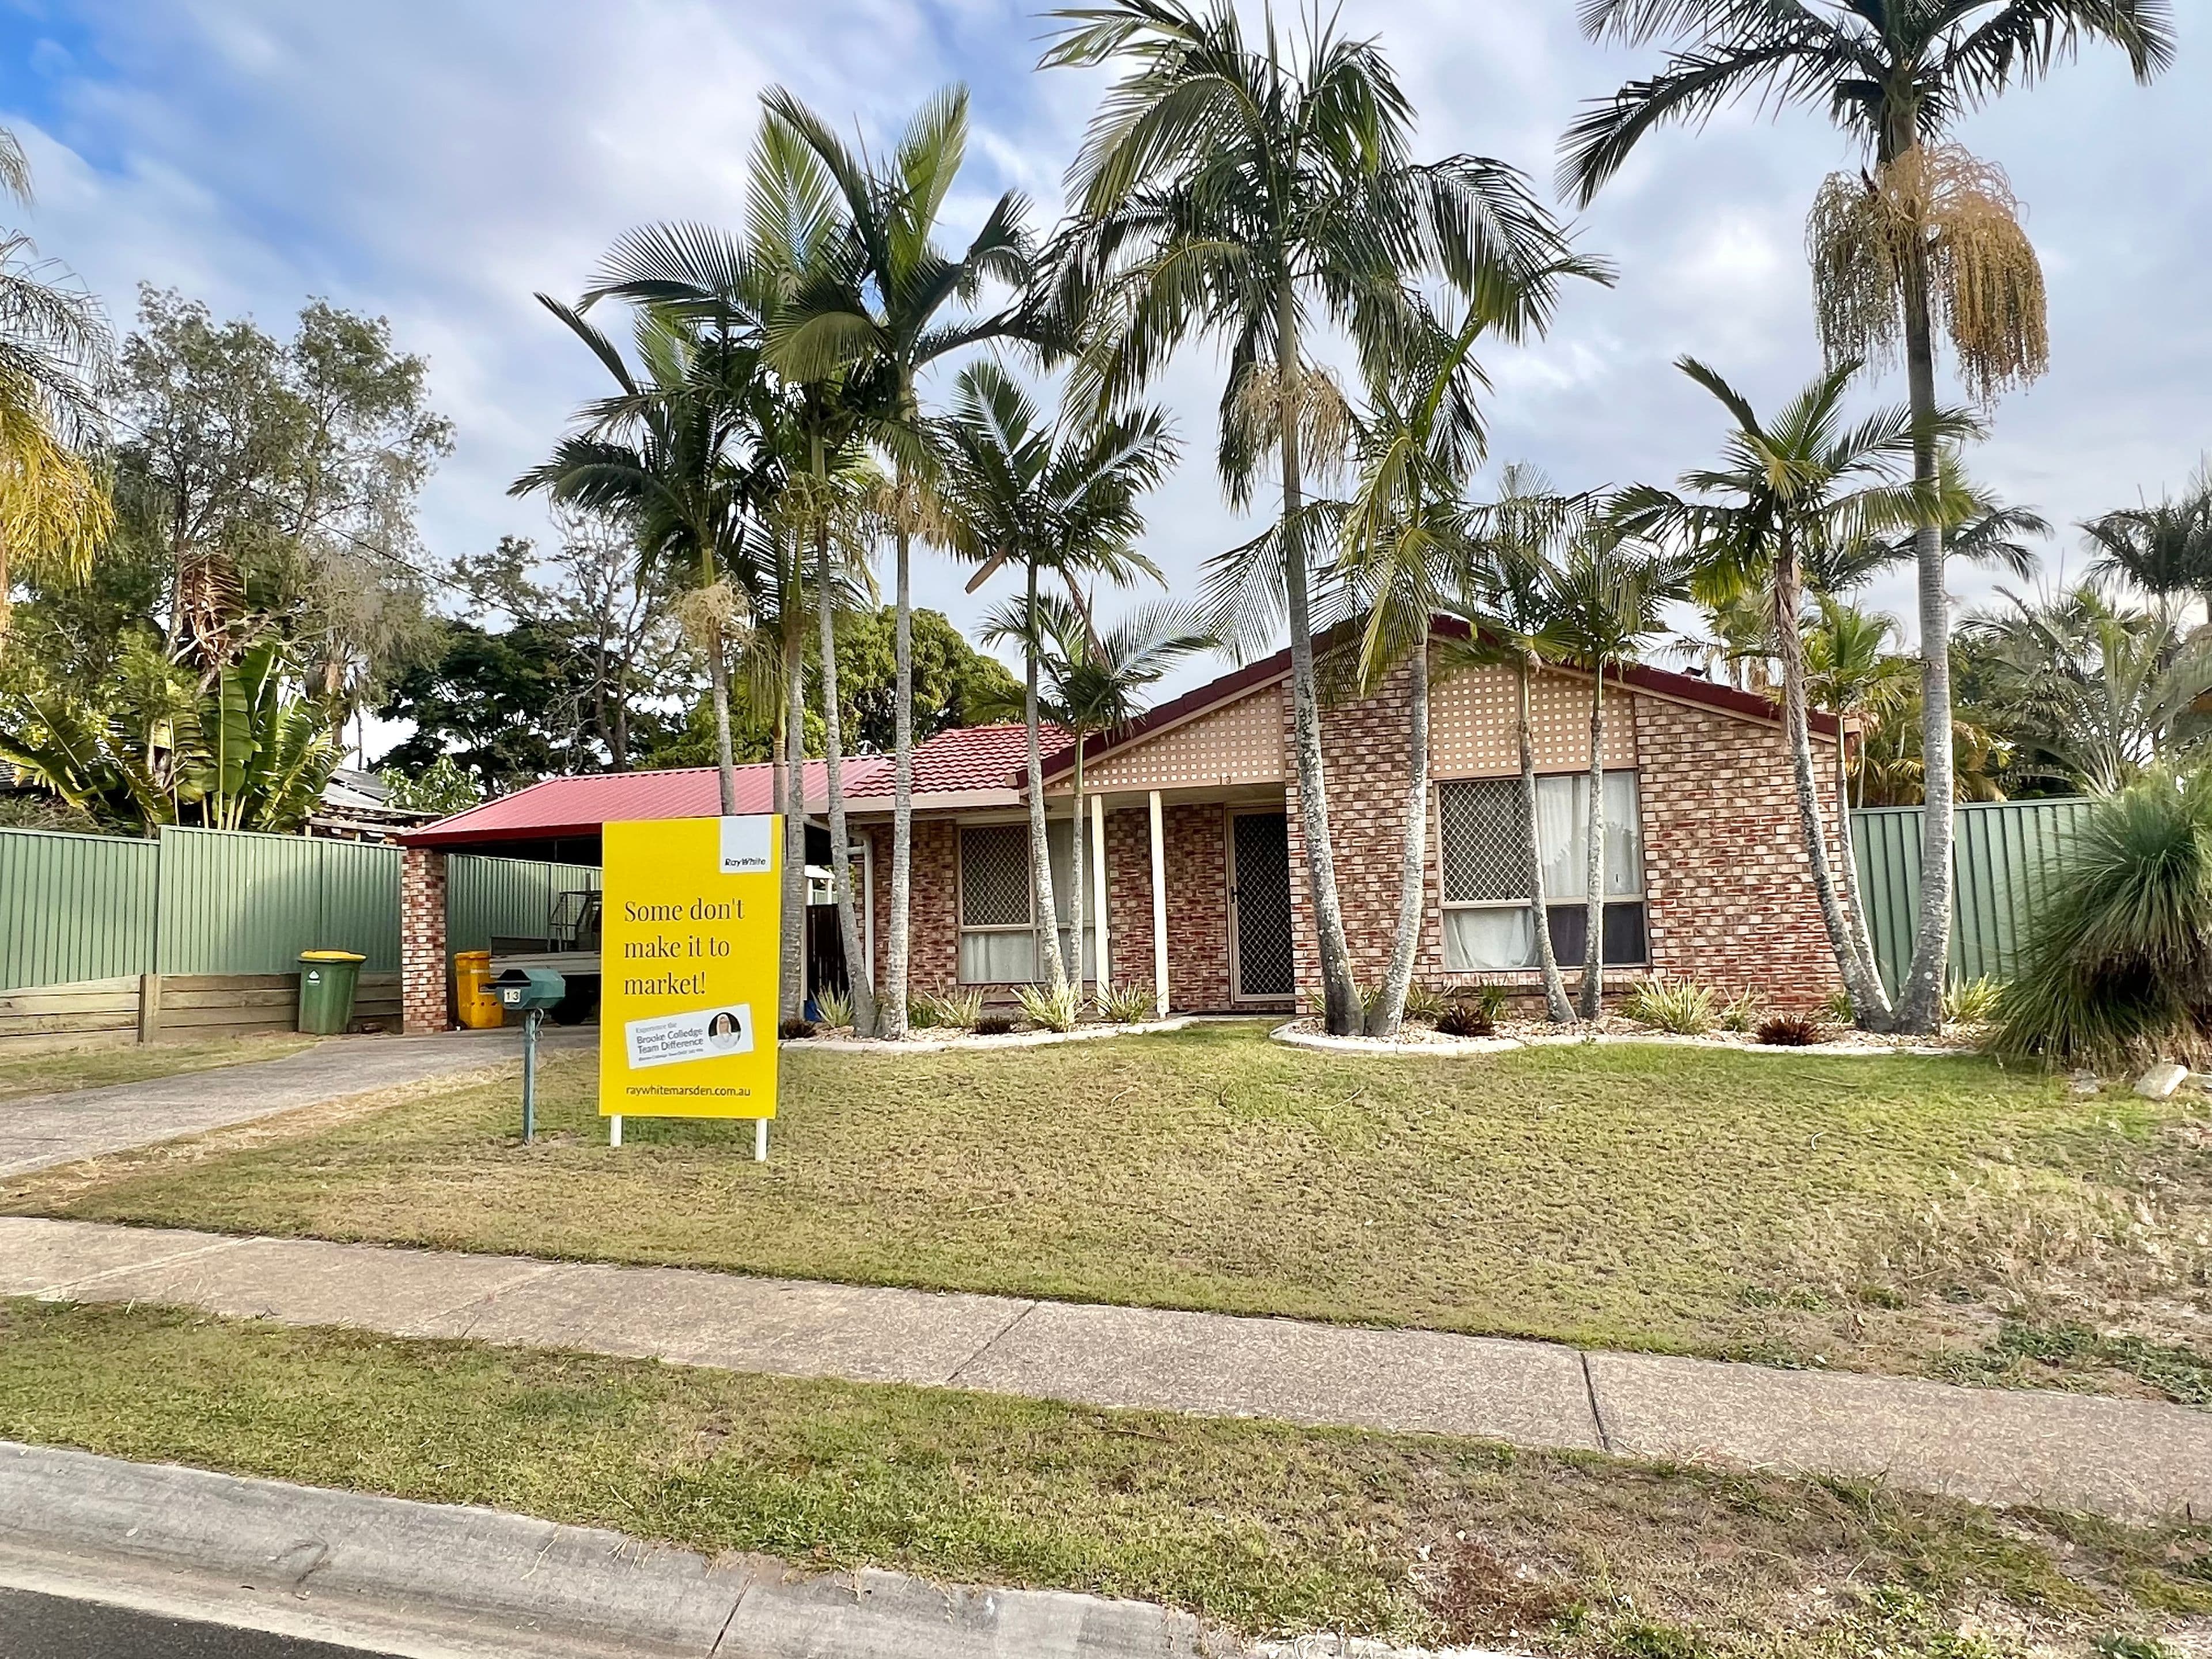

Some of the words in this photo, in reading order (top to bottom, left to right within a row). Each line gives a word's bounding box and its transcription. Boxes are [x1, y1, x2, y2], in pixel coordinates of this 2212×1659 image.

[624, 900, 683, 922] Some
[690, 897, 745, 921] don't
[624, 935, 681, 958] make
[688, 935, 703, 957] it
[710, 937, 730, 957] to
[623, 971, 706, 995] market!
[507, 991, 519, 1001] 13
[637, 1034, 666, 1044] Brooke
[667, 1028, 703, 1040] Colledge
[638, 1044, 660, 1054] Team
[661, 1038, 703, 1051] Difference
[626, 1085, 751, 1096] raywhitemarsden.com.au
